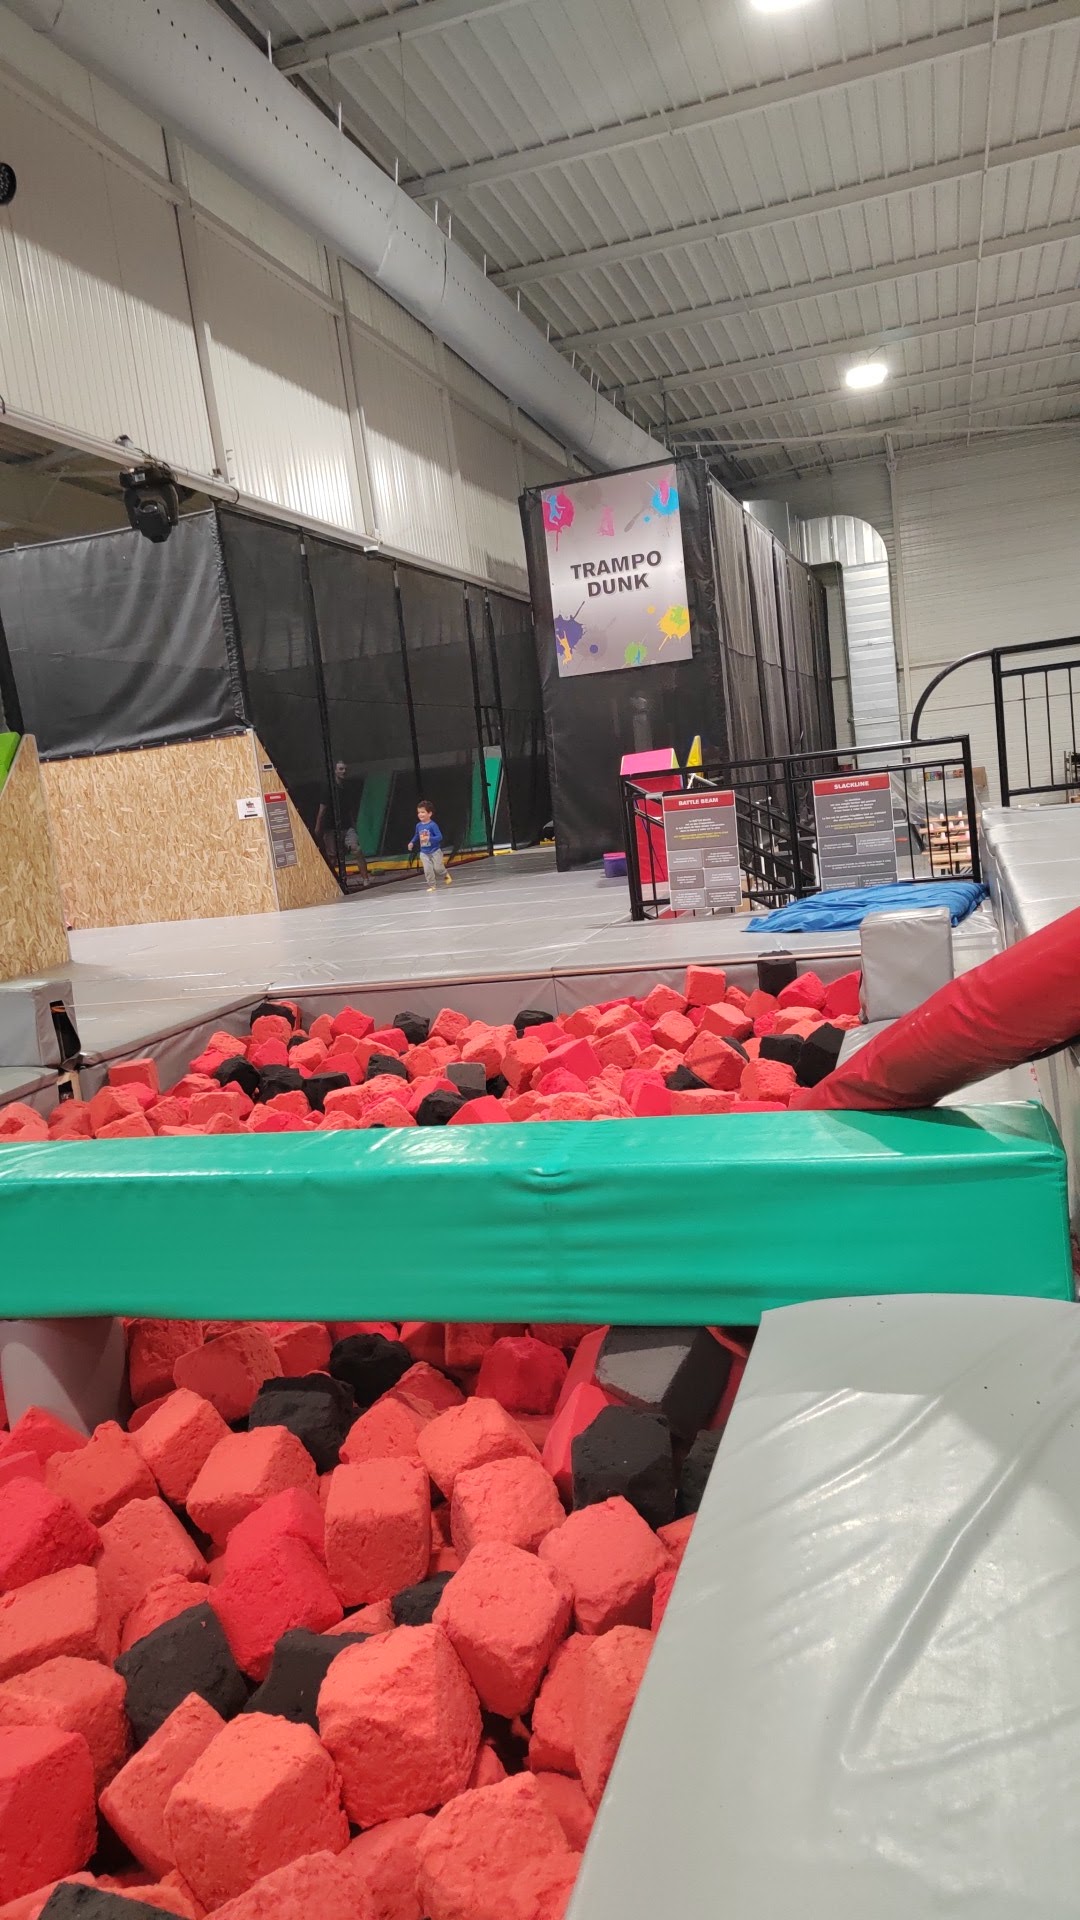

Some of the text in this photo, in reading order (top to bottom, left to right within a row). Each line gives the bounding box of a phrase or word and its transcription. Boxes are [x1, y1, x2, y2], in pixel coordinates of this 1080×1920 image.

[570, 550, 662, 580] TRAMPO
[587, 573, 649, 598] DUNK
[833, 780, 869, 790] SLACKLINE
[678, 798, 699, 806] BATTLE
